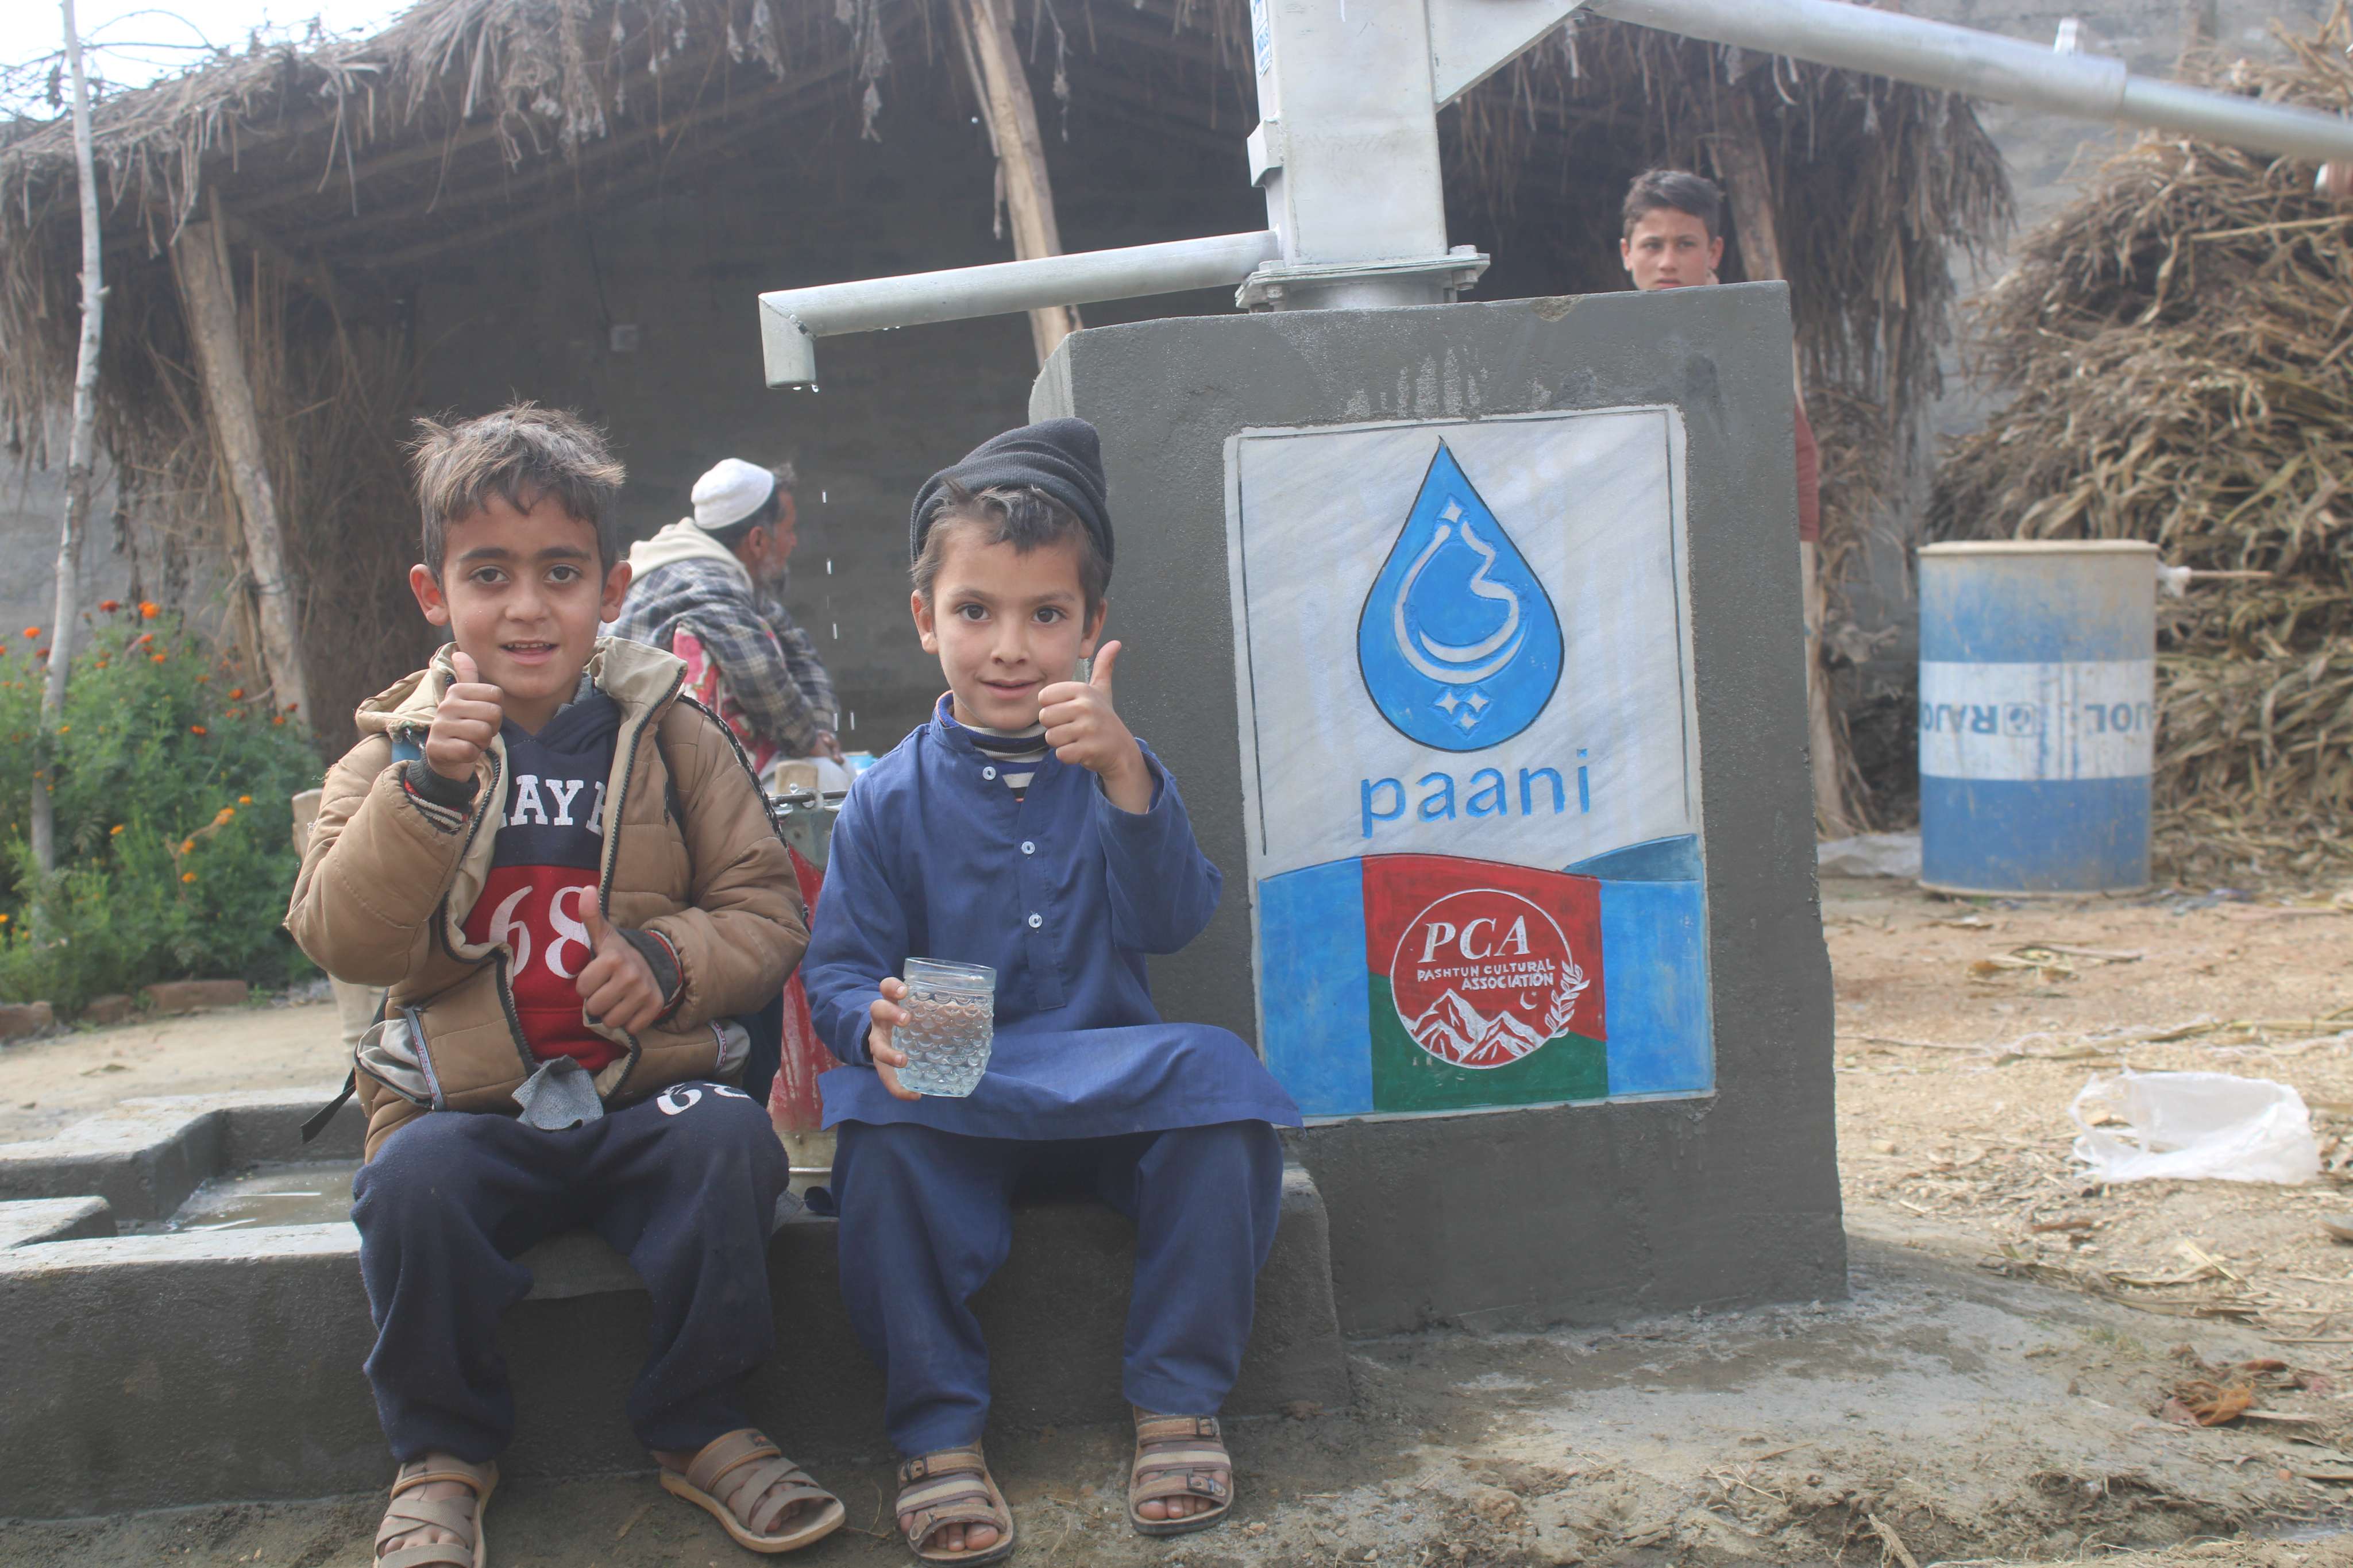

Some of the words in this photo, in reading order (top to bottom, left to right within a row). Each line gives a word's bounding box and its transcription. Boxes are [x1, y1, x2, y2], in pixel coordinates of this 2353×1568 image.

[1360, 748, 1590, 838] paani
[489, 885, 592, 979] 68
[1417, 915, 1531, 963] PCA
[1417, 965, 1480, 982] PASHTUN
[1483, 958, 1556, 975] CULTURAL
[1461, 972, 1554, 991] ASSOCIATION
